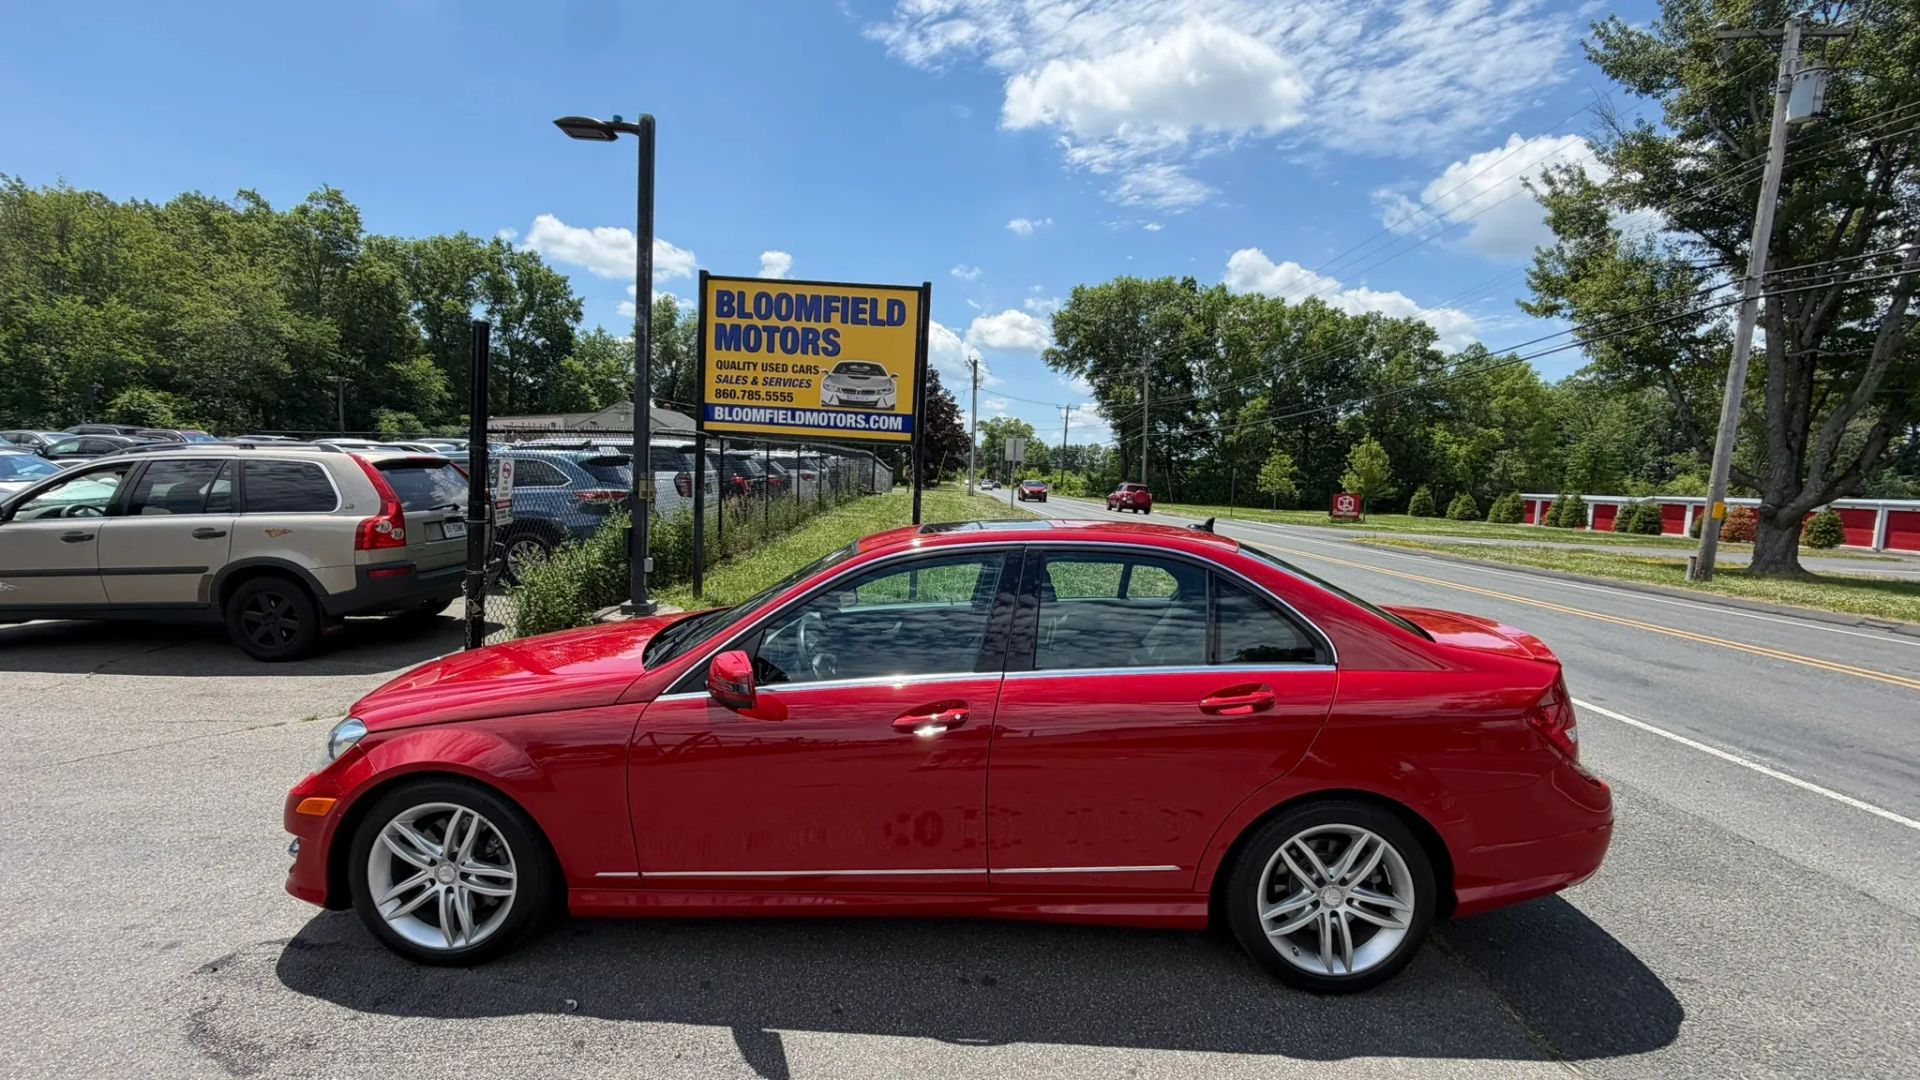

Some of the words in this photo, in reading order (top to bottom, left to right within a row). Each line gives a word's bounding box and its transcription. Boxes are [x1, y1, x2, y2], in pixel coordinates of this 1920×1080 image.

[715, 289, 906, 327] BLOOMFIELD
[714, 323, 841, 357] MOTORS
[716, 360, 758, 371] QUALITY
[761, 362, 788, 373] USED
[792, 364, 820, 375] CARS
[715, 374, 748, 385] SALES
[751, 376, 758, 386] &
[761, 377, 812, 389] SERVICES
[715, 389, 794, 402] 860.785.5555
[714, 407, 902, 430] BLOOMFIELDMOTORS.COM
